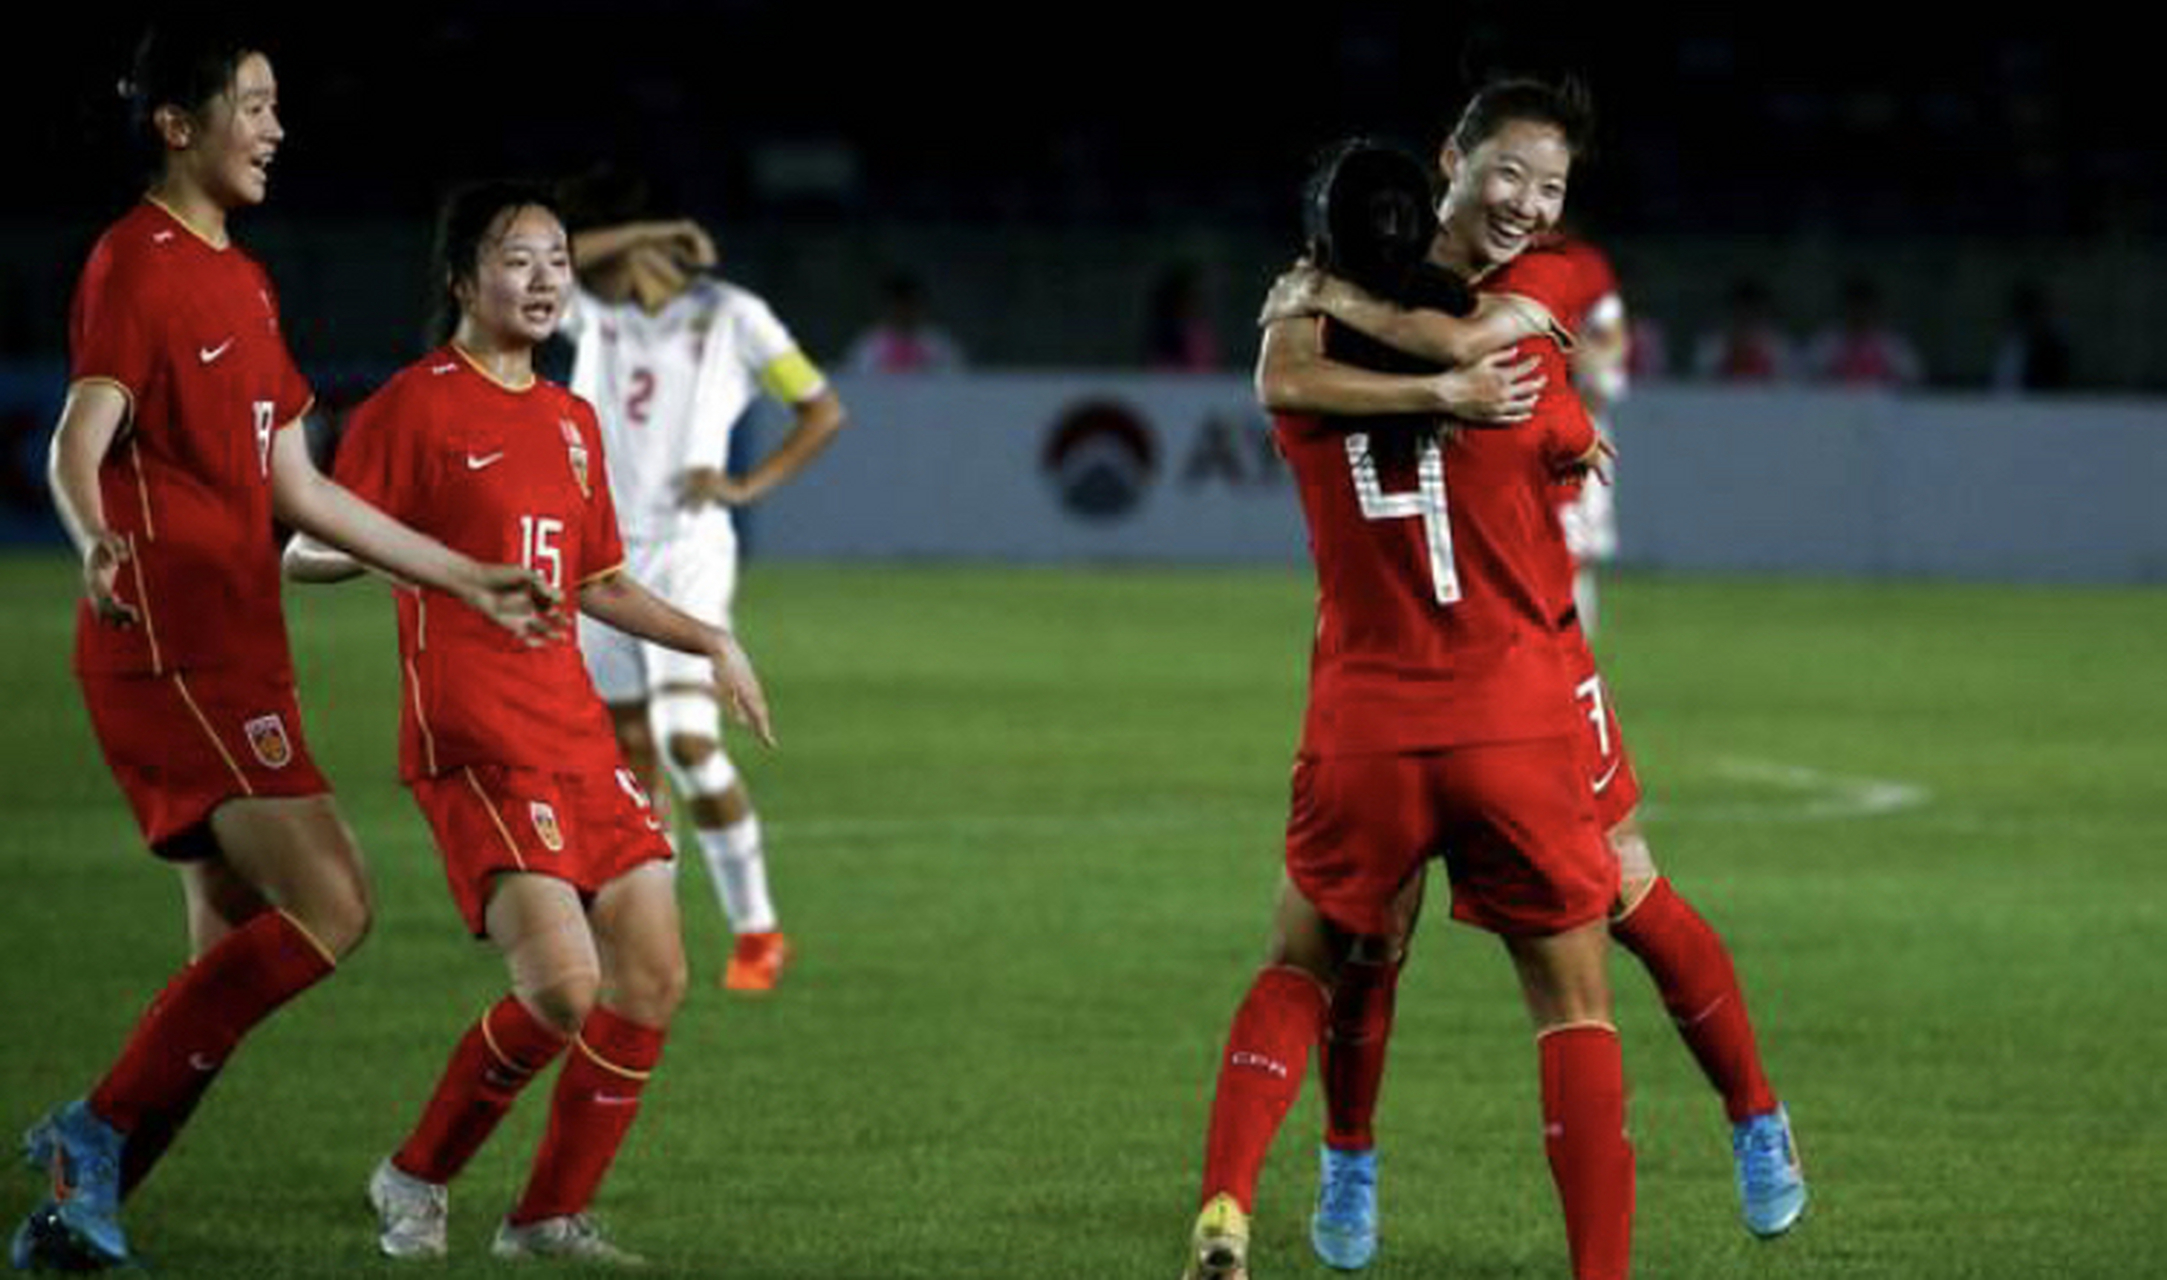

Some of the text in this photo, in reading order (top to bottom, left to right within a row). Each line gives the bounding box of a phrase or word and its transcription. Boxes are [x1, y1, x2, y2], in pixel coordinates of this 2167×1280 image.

[626, 366, 656, 425] 2
[519, 515, 564, 591] 15
[1345, 432, 1464, 606] 4
